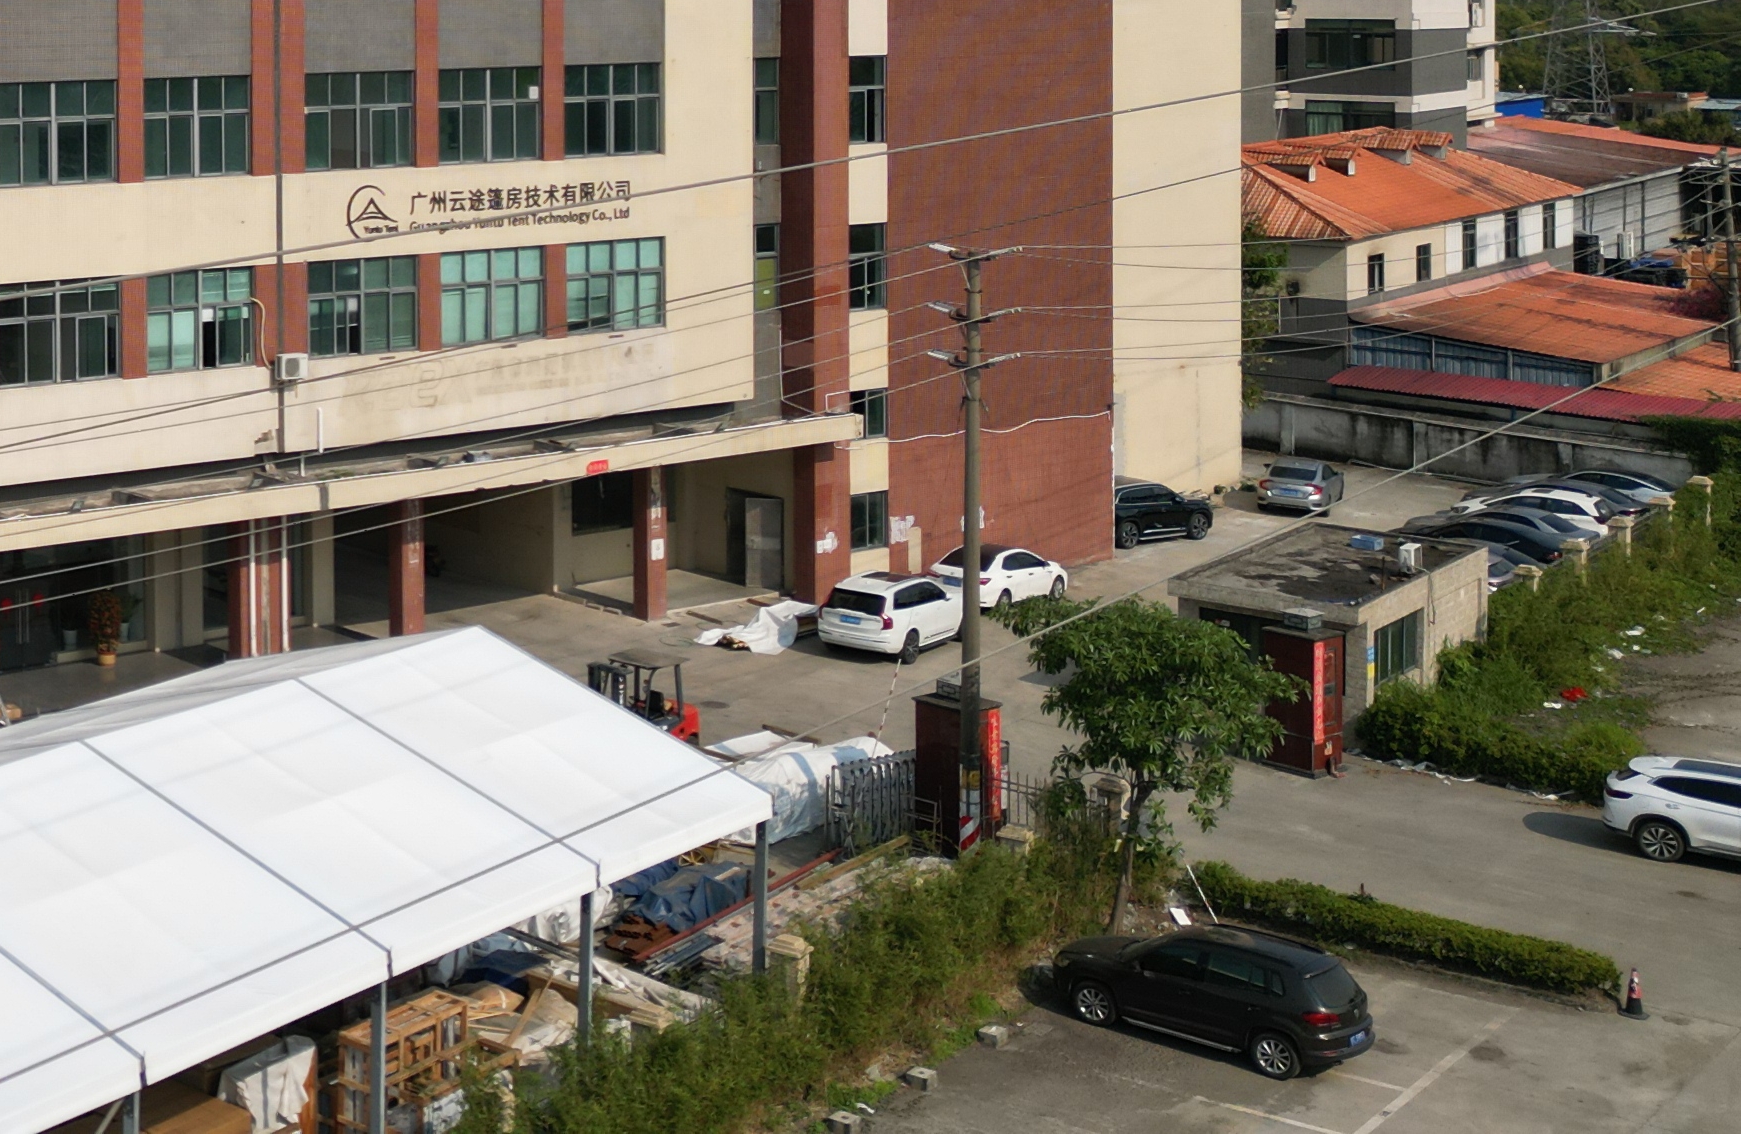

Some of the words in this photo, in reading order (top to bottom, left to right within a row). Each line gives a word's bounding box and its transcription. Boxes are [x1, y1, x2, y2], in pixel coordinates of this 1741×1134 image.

[409, 180, 631, 215] 广州云途篷房技术有限公司
[531, 211, 591, 225] Technology
[614, 206, 630, 220] Ltd
